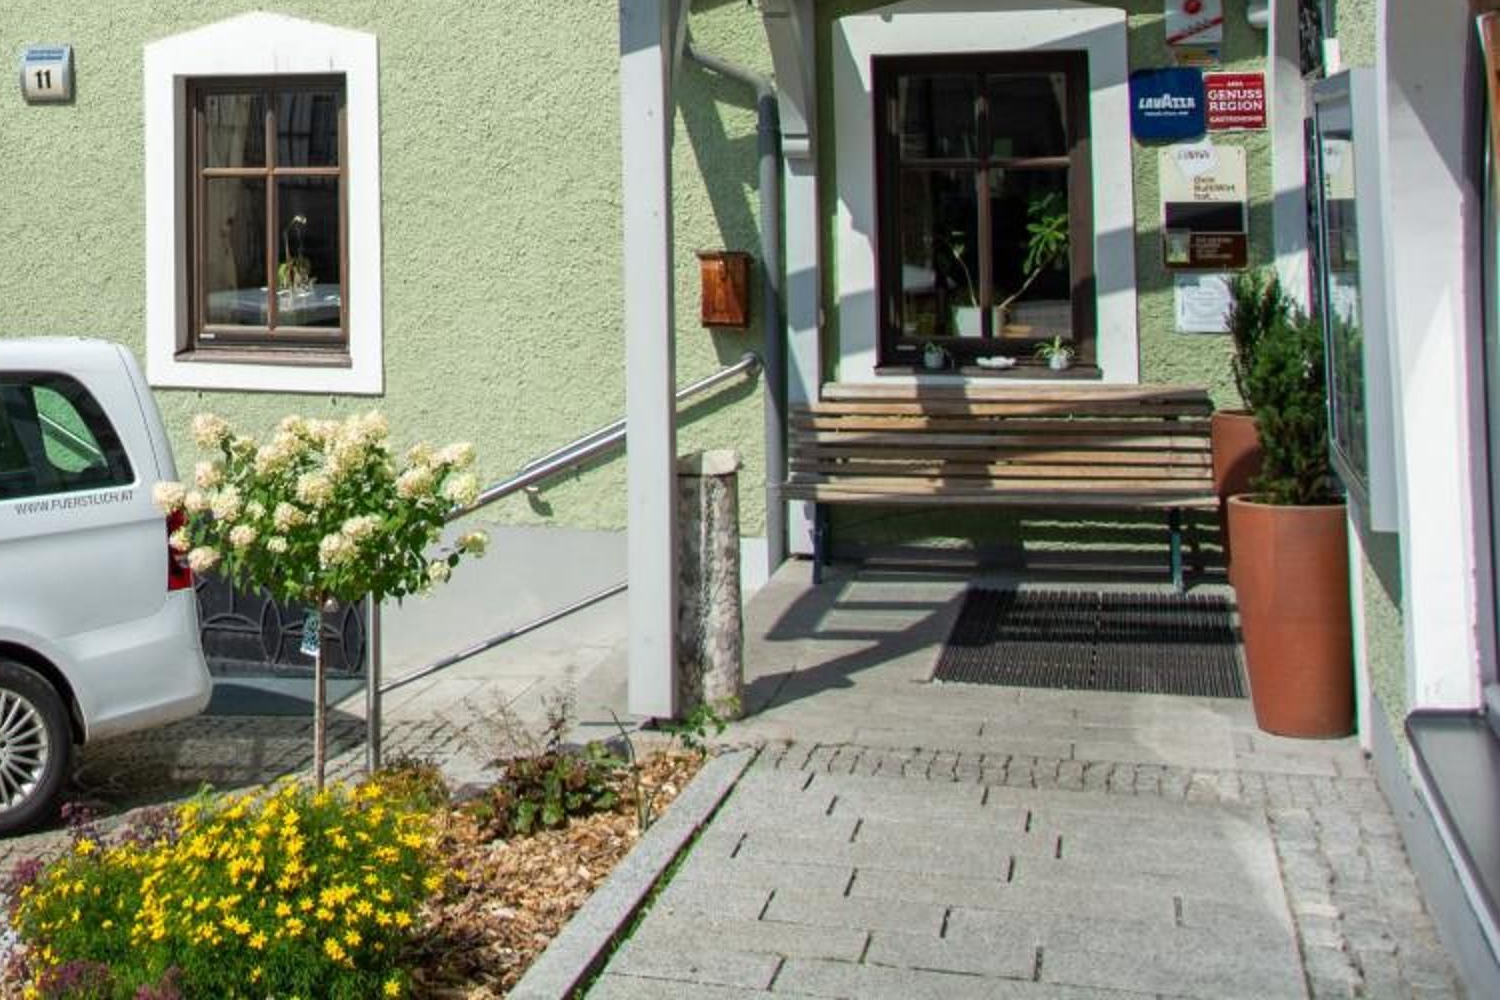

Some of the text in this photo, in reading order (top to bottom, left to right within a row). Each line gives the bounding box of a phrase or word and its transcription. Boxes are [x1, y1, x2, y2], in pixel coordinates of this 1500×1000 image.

[36, 69, 51, 89] 11
[1138, 92, 1197, 110] LAVAZZA
[1207, 88, 1263, 101] GENUSS
[1209, 100, 1263, 112] REGION
